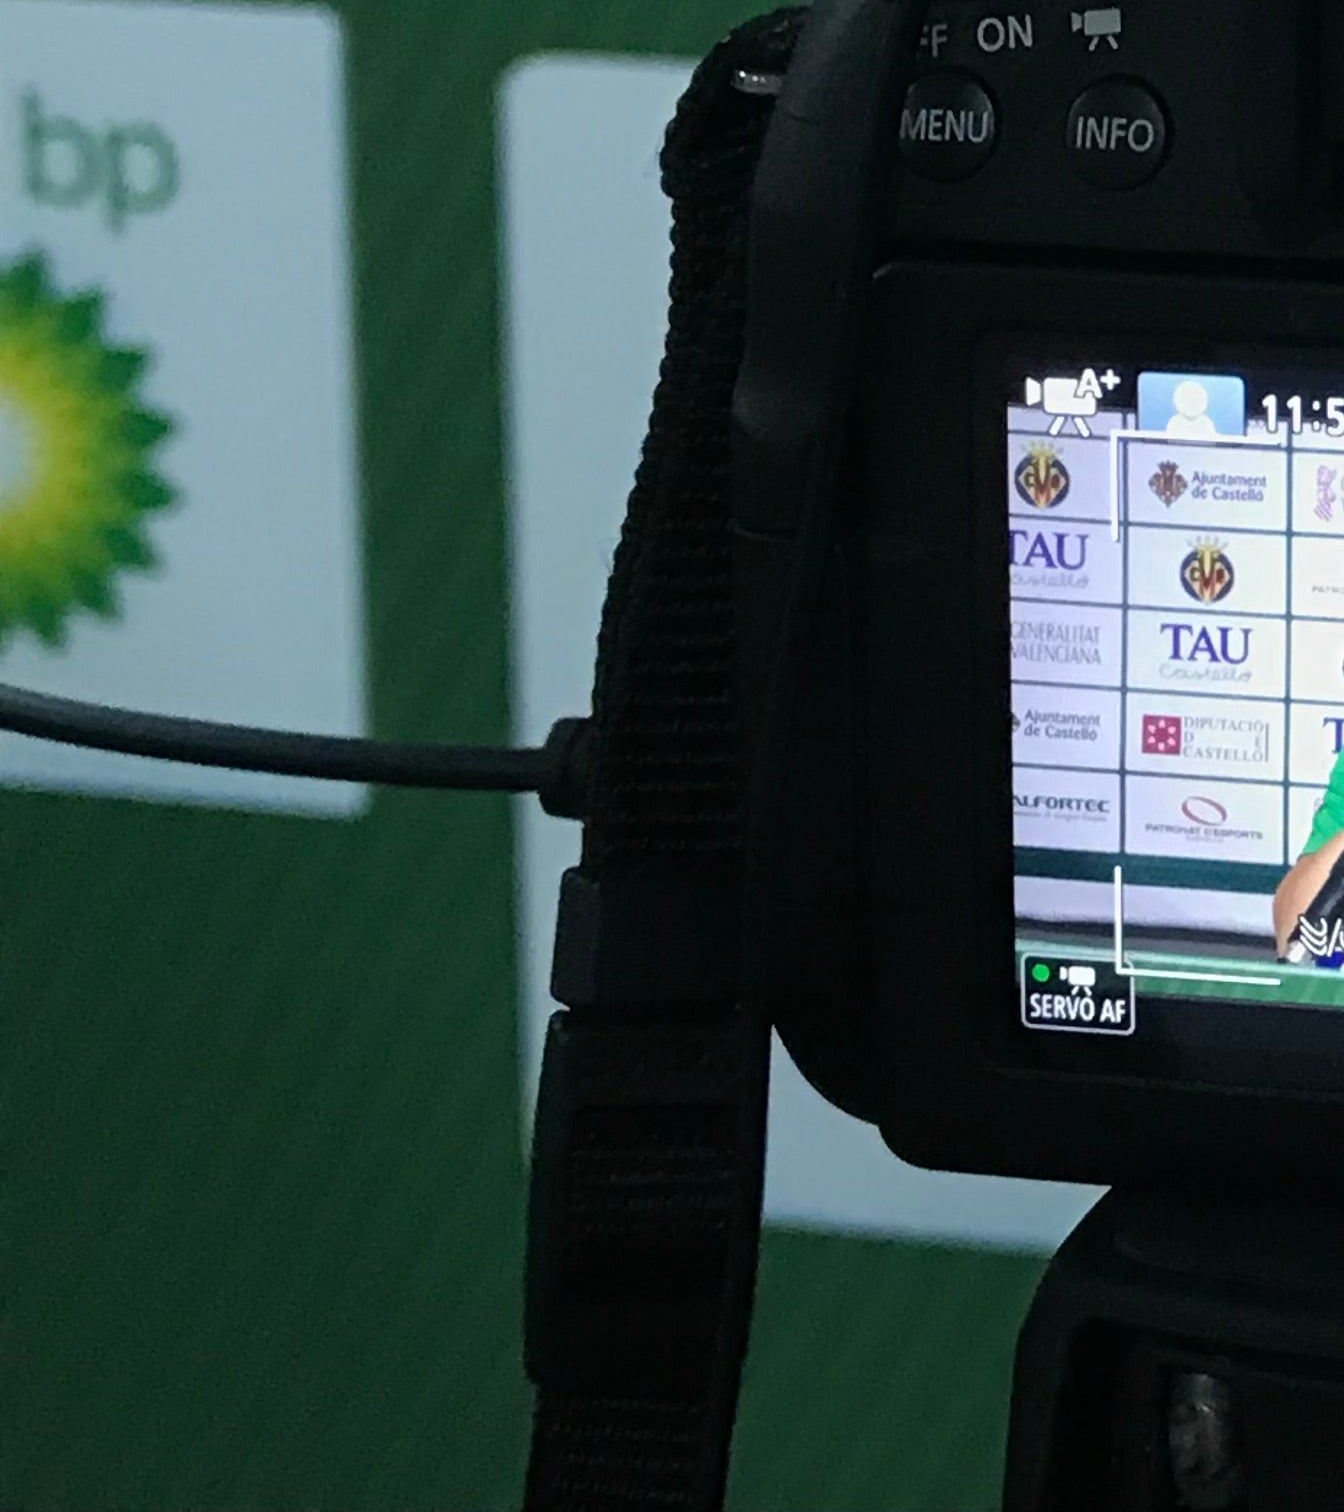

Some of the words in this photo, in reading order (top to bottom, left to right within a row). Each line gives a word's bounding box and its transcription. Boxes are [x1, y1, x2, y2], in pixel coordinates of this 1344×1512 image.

[977, 13, 1033, 53] ON
[900, 108, 989, 144] MENU
[1076, 116, 1155, 153] INFO
[22, 86, 181, 236] bp
[1191, 470, 1268, 490] Ajuntament
[1191, 486, 1208, 501] de
[1211, 487, 1265, 503] Castelló
[1008, 529, 1090, 570] TAU
[1159, 622, 1253, 665] TAU
[1023, 708, 1102, 729] Ajuntament
[1023, 724, 1041, 738] de
[1029, 992, 1095, 1022] SERVO
[1099, 999, 1127, 1025] AF
